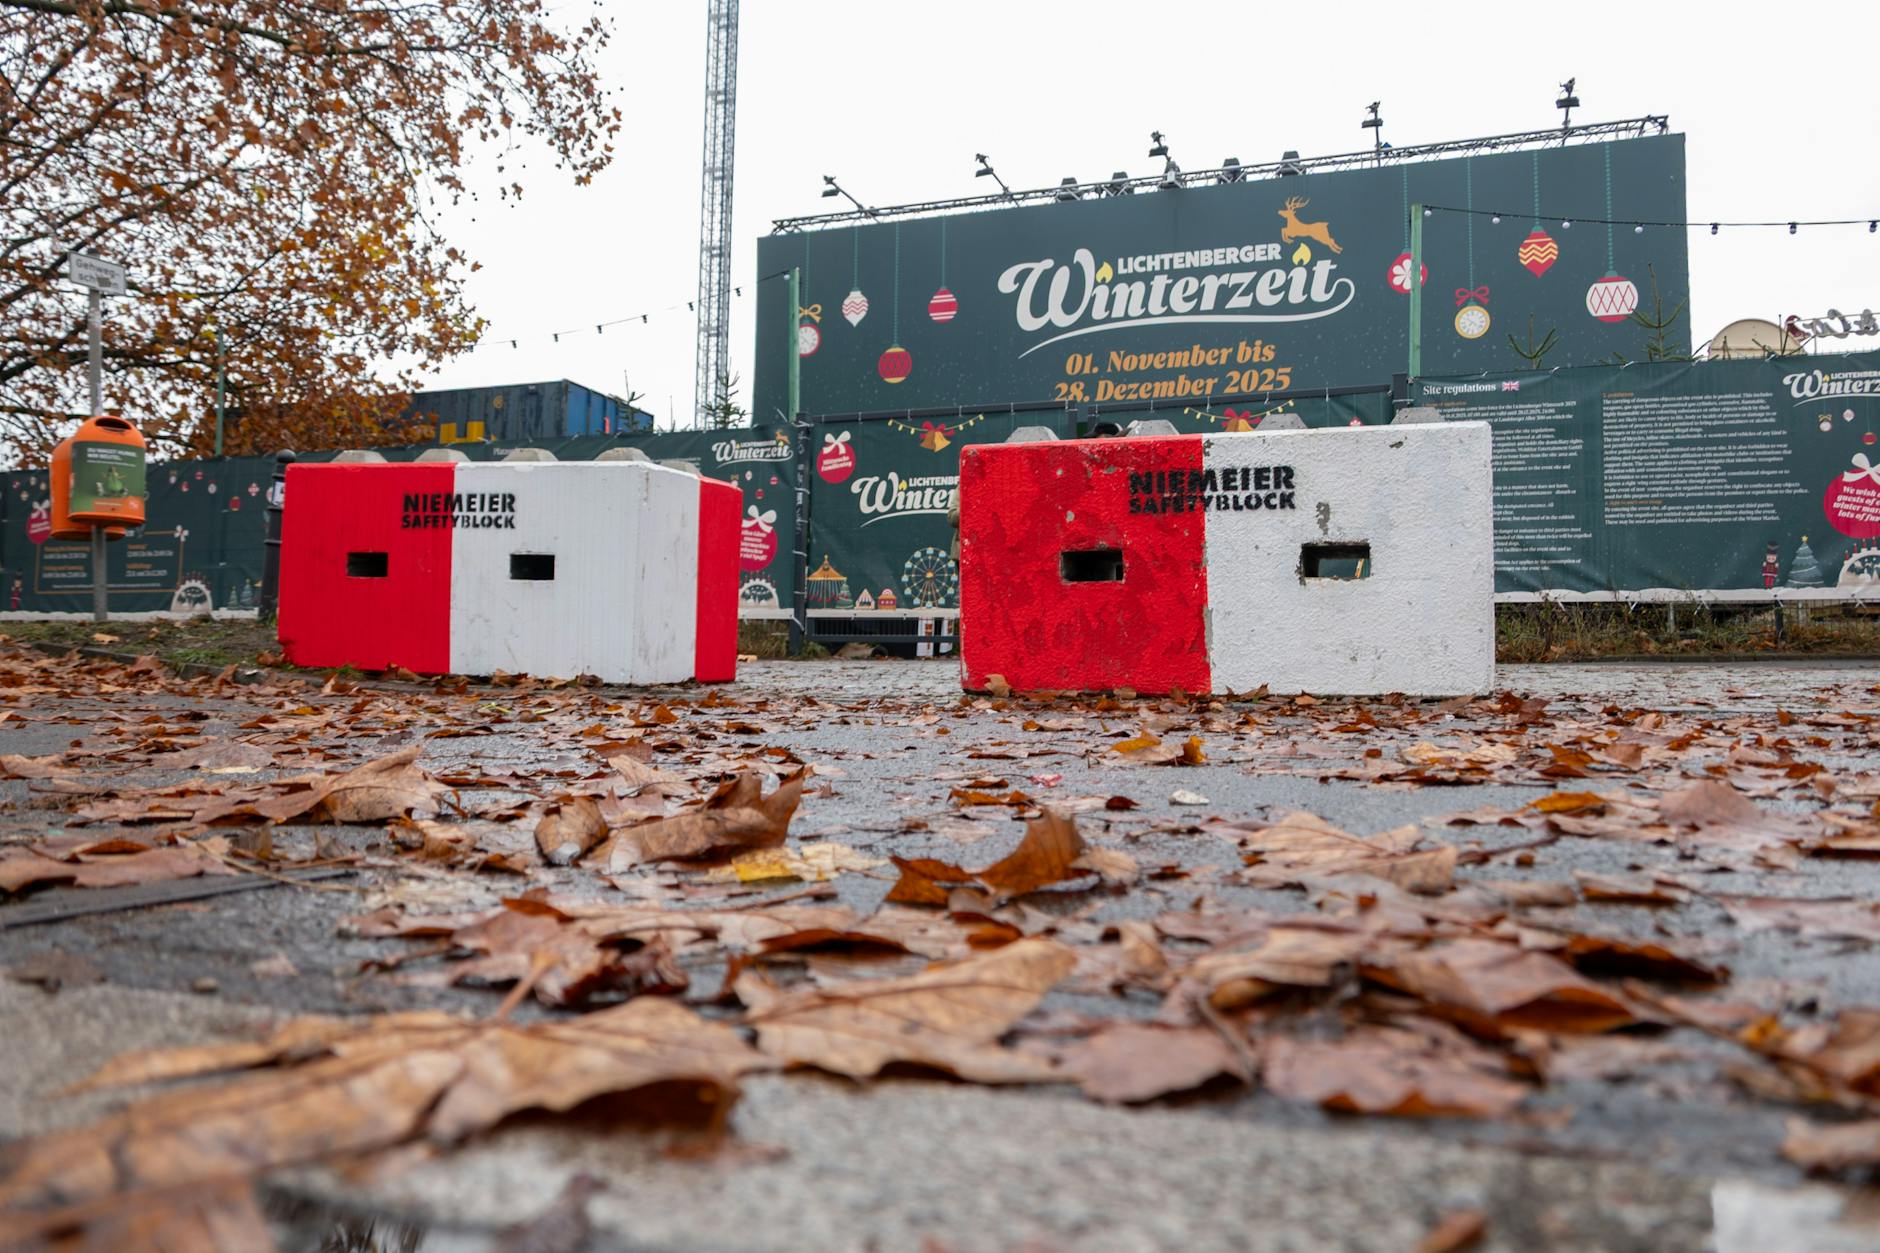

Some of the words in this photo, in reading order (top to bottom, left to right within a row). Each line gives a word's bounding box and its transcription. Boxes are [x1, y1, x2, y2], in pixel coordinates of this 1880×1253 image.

[1117, 243, 1282, 275] LICHTENBERGER
[998, 247, 1354, 345] Winterzeit
[1065, 353, 1099, 376] 01.
[1107, 341, 1233, 373] November
[1236, 339, 1277, 363] bis
[1054, 382, 1090, 402] 28.
[1095, 374, 1219, 401] Dezember
[1223, 367, 1293, 394] 2025
[1422, 385, 1441, 396] Site
[1443, 382, 1496, 396] regulations
[711, 439, 794, 466] Winterzeit
[1128, 465, 1296, 495] NIEMEIER
[1836, 494, 1864, 503] guests
[1842, 486, 1855, 494] We
[1855, 488, 1877, 497] wish
[403, 493, 516, 513] NIEMEIER
[1128, 491, 1296, 515] SAFETYBLOCK
[1833, 502, 1861, 511] winter
[1838, 509, 1855, 519] lots
[402, 514, 516, 529] SAFETYBLOCK
